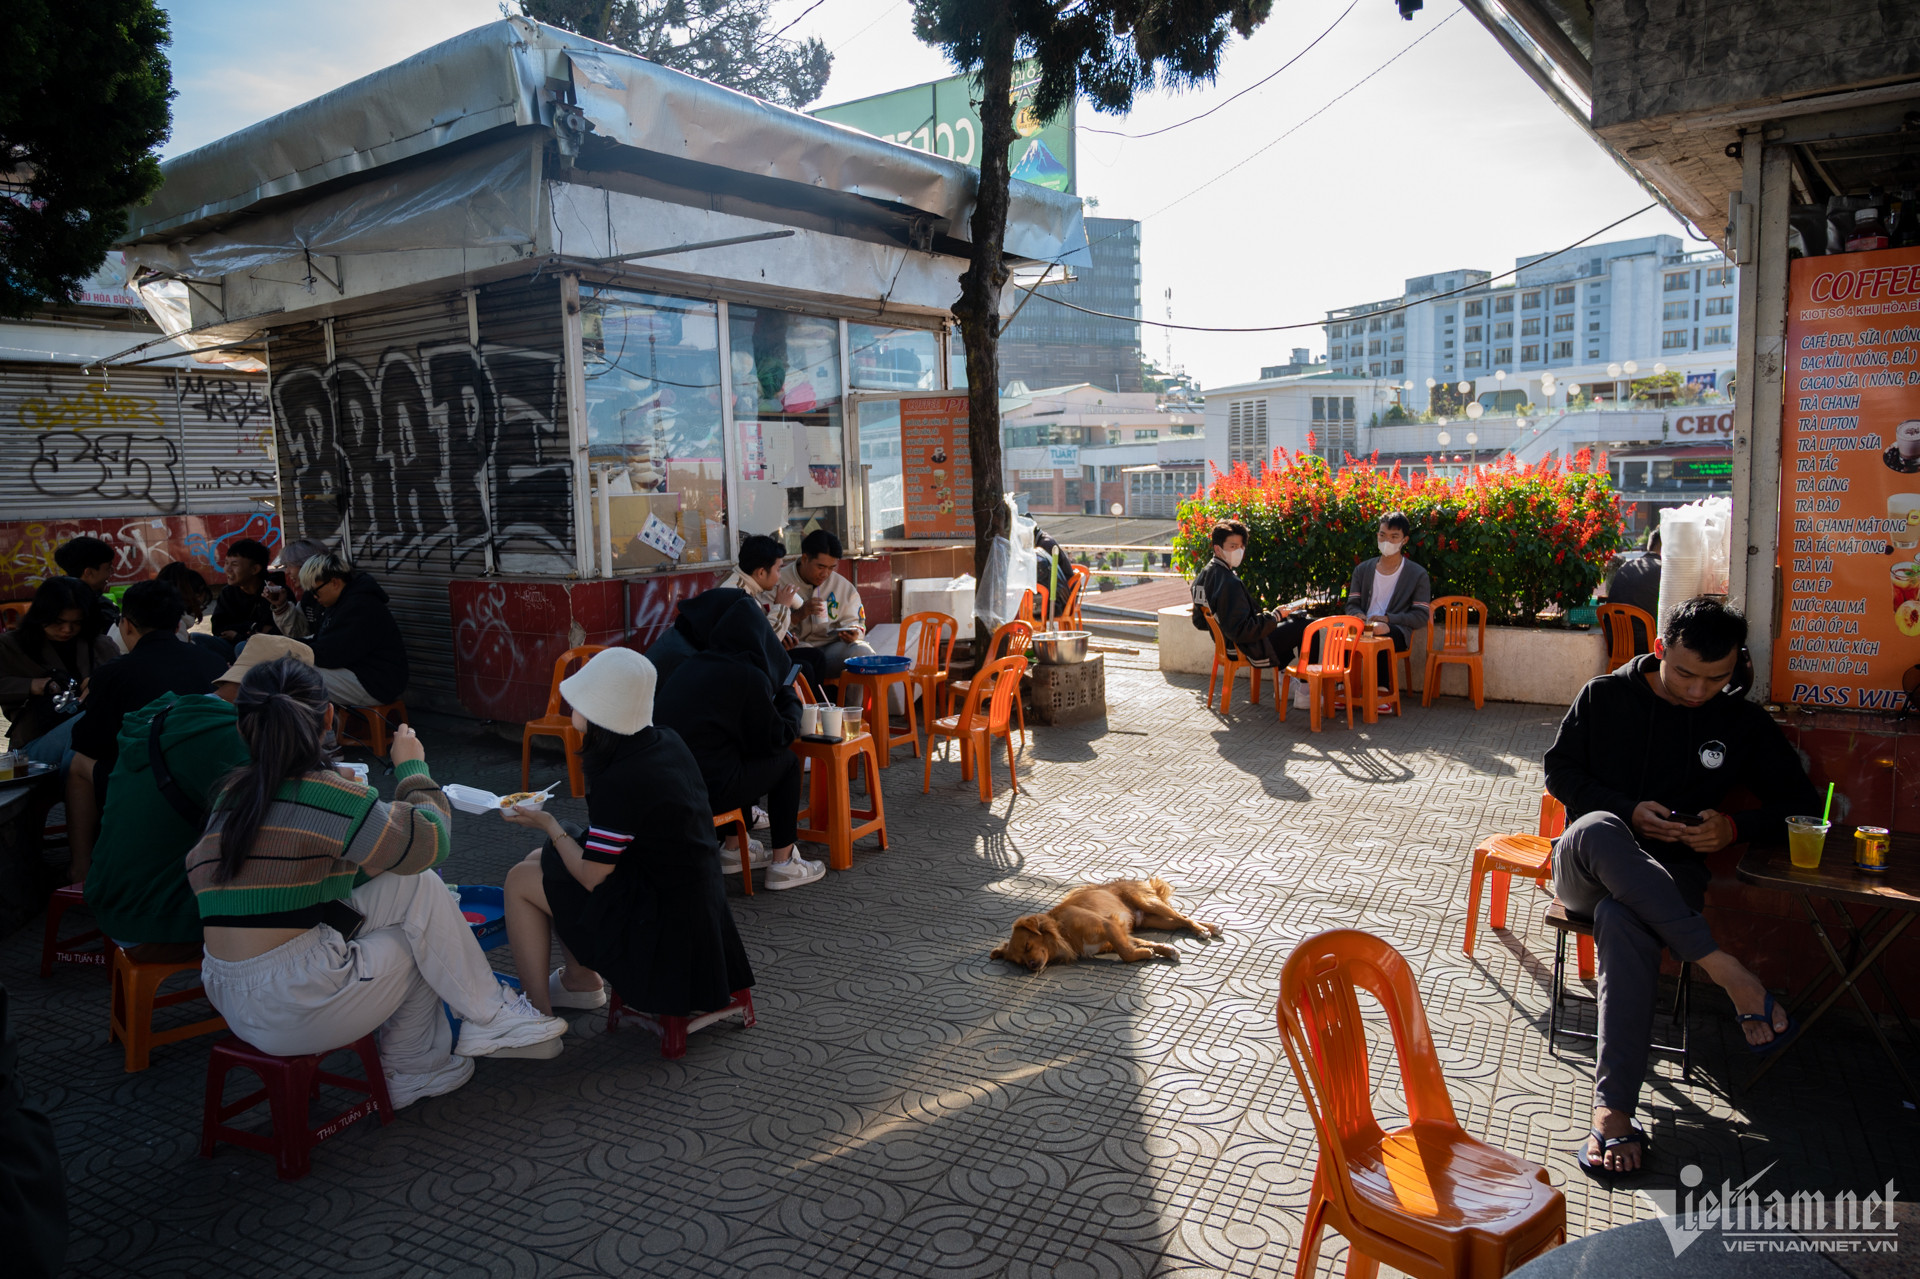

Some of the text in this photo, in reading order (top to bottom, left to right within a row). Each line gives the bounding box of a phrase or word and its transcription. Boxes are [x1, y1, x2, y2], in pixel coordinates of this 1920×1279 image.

[1801, 309, 1827, 321] KIOT
[1846, 307, 1854, 317] 4
[1856, 304, 1880, 316] KHU
[1882, 300, 1907, 314] HÒA
[1801, 331, 1828, 350] CAFÉ
[1857, 328, 1881, 346] SỮA
[1801, 355, 1823, 374] BẠC
[1800, 376, 1835, 391] CACAO
[1836, 372, 1859, 389] SỮA
[1798, 393, 1861, 411] TRÀ CHANH
[1798, 415, 1859, 432] TRÀ LIPTON
[1797, 433, 1882, 453] TRÀ LIPTON SỮA
[1796, 457, 1817, 472] TRÀ
[1795, 476, 1850, 493] TRÀ GỪNG
[1795, 497, 1841, 513] TRÀ ĐÀO
[1794, 516, 1907, 535] TRÀ CHANH MẬT ONG
[1793, 537, 1814, 553] TRÀ
[1836, 536, 1861, 556] MẬT
[1861, 539, 1886, 554] ONG
[1792, 557, 1813, 573] TRÀ
[1792, 577, 1832, 593] CAM ÉP
[1823, 600, 1846, 614] RAU
[1847, 598, 1866, 615] MÁ
[1790, 616, 1858, 635] MÌ GÓI ỐP LA
[1789, 637, 1879, 656] MÌ GÓI XÚC XÍCH
[1788, 656, 1869, 675] BÁNH MÌ ỐP LA
[1791, 684, 1914, 710] PASS WIF
[316, 1124, 337, 1140] THU
